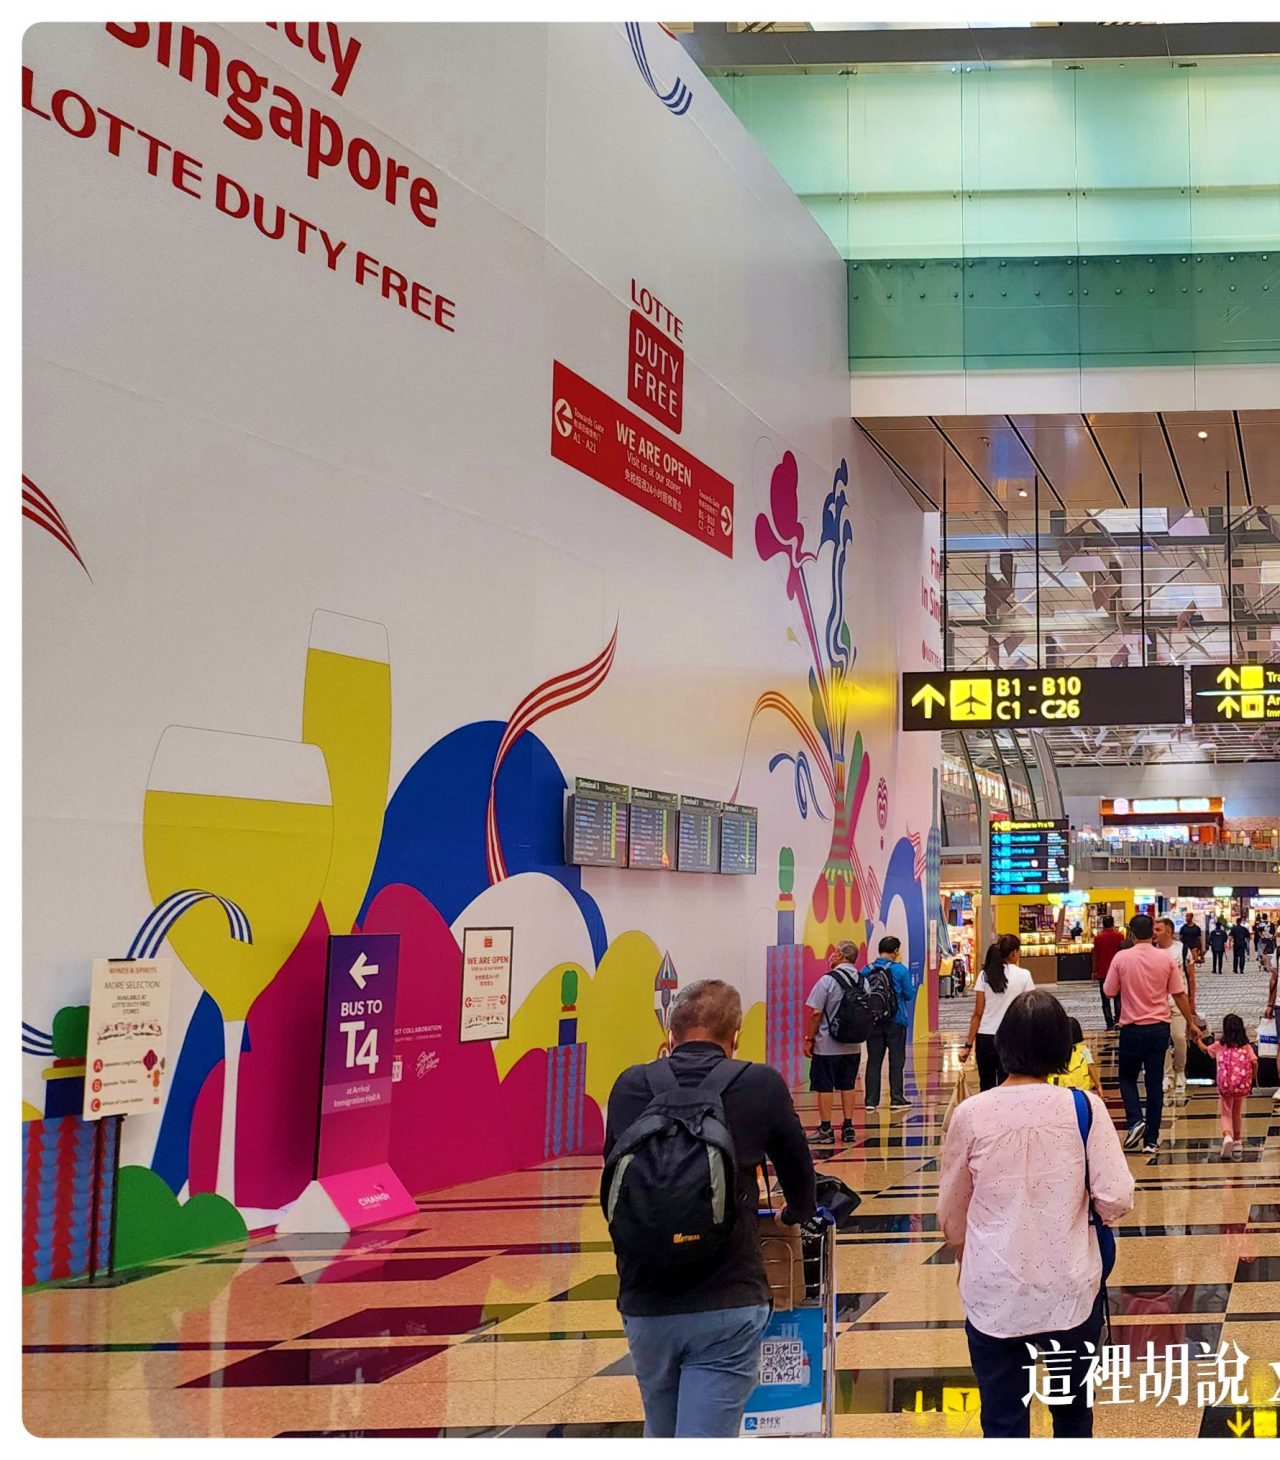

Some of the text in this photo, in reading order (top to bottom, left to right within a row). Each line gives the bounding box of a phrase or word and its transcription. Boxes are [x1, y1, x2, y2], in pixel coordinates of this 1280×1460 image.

[22, 66, 456, 333] LOTTE DUTY FREE
[630, 277, 684, 344] LOTTE
[635, 327, 679, 384] DUTY
[634, 362, 678, 418] FREE
[616, 420, 636, 451] WE
[638, 437, 661, 468] ARE
[663, 453, 692, 488] OPEN
[996, 678, 1021, 697] B1
[1042, 676, 1082, 696] B10
[996, 701, 1021, 720] C1
[1040, 699, 1081, 719] C26
[104, 980, 160, 989] MORE SELECTION
[479, 956, 491, 965] ARE
[492, 955, 509, 964] OPEN
[340, 999, 383, 1017] BUS TO
[339, 1020, 379, 1075] T4
